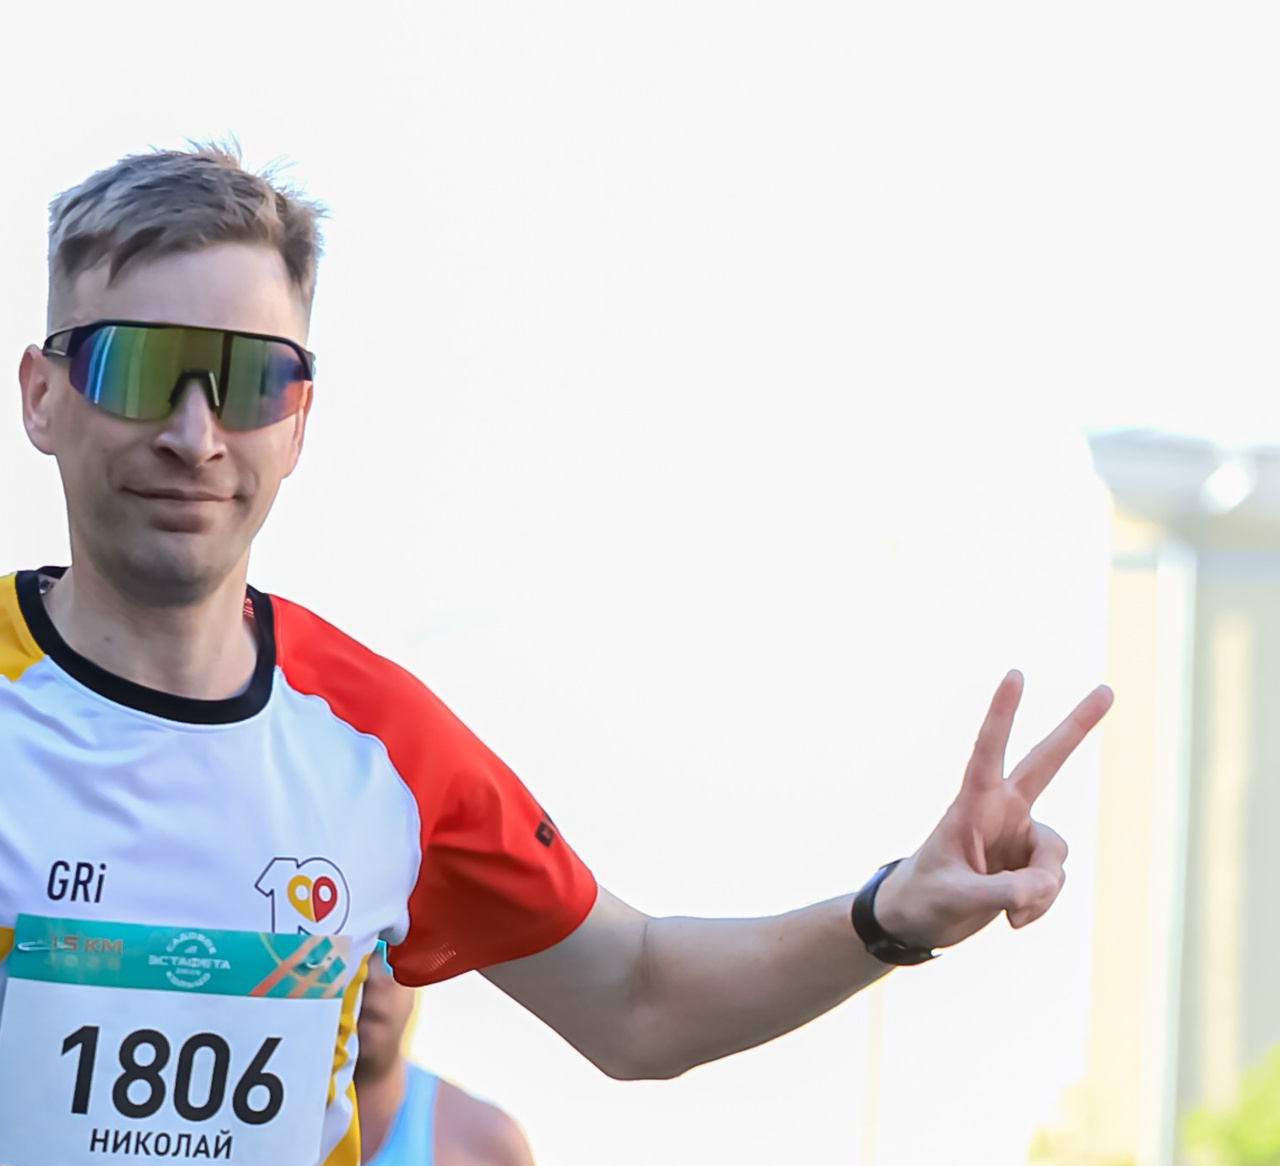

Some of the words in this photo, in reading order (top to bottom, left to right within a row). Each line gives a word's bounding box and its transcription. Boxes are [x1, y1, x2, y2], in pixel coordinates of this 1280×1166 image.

[47, 860, 107, 903] GRi
[61, 1025, 284, 1125] 1806
[90, 1129, 233, 1159] НИКОЛАЙ
